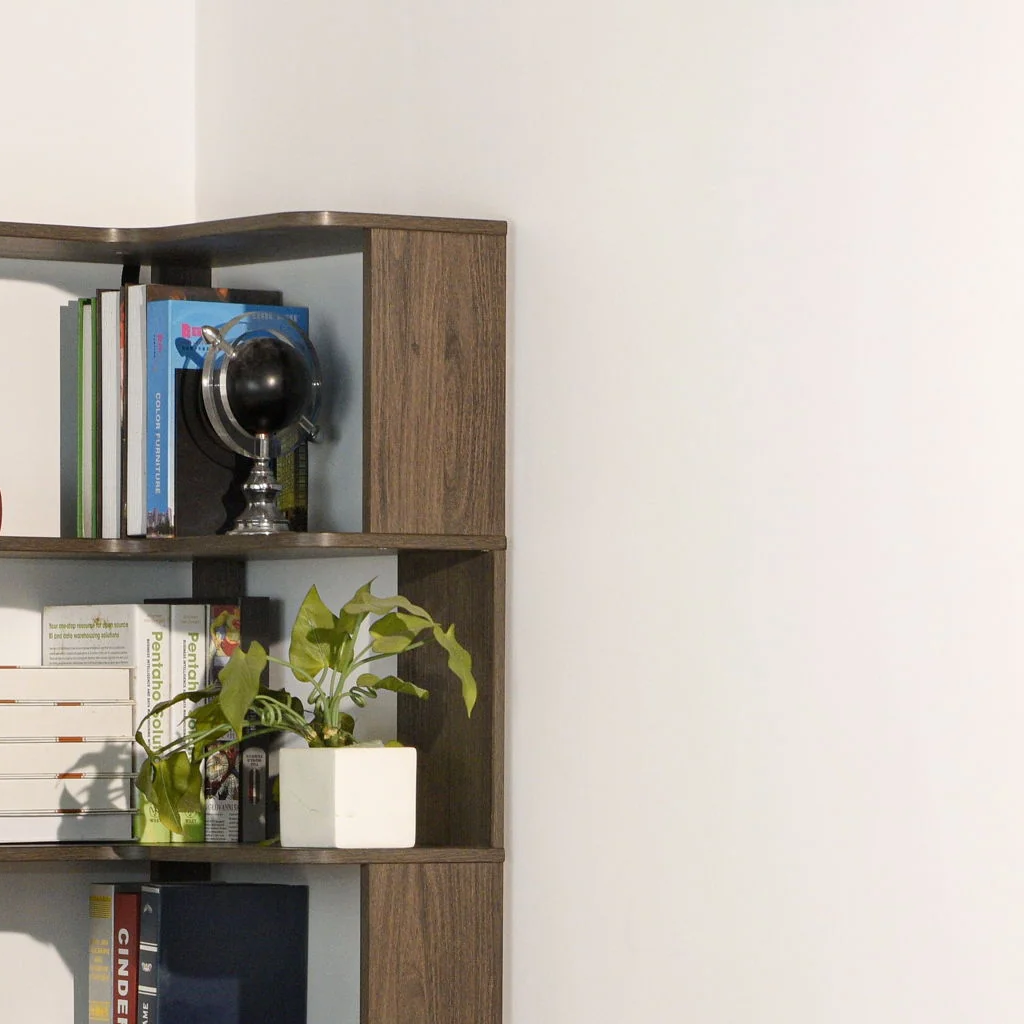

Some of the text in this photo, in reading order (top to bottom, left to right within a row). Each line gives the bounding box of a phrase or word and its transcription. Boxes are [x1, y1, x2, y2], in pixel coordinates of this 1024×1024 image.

[151, 631, 164, 701] Pentaho
[188, 631, 200, 690] Pentah
[152, 712, 164, 749] Solut
